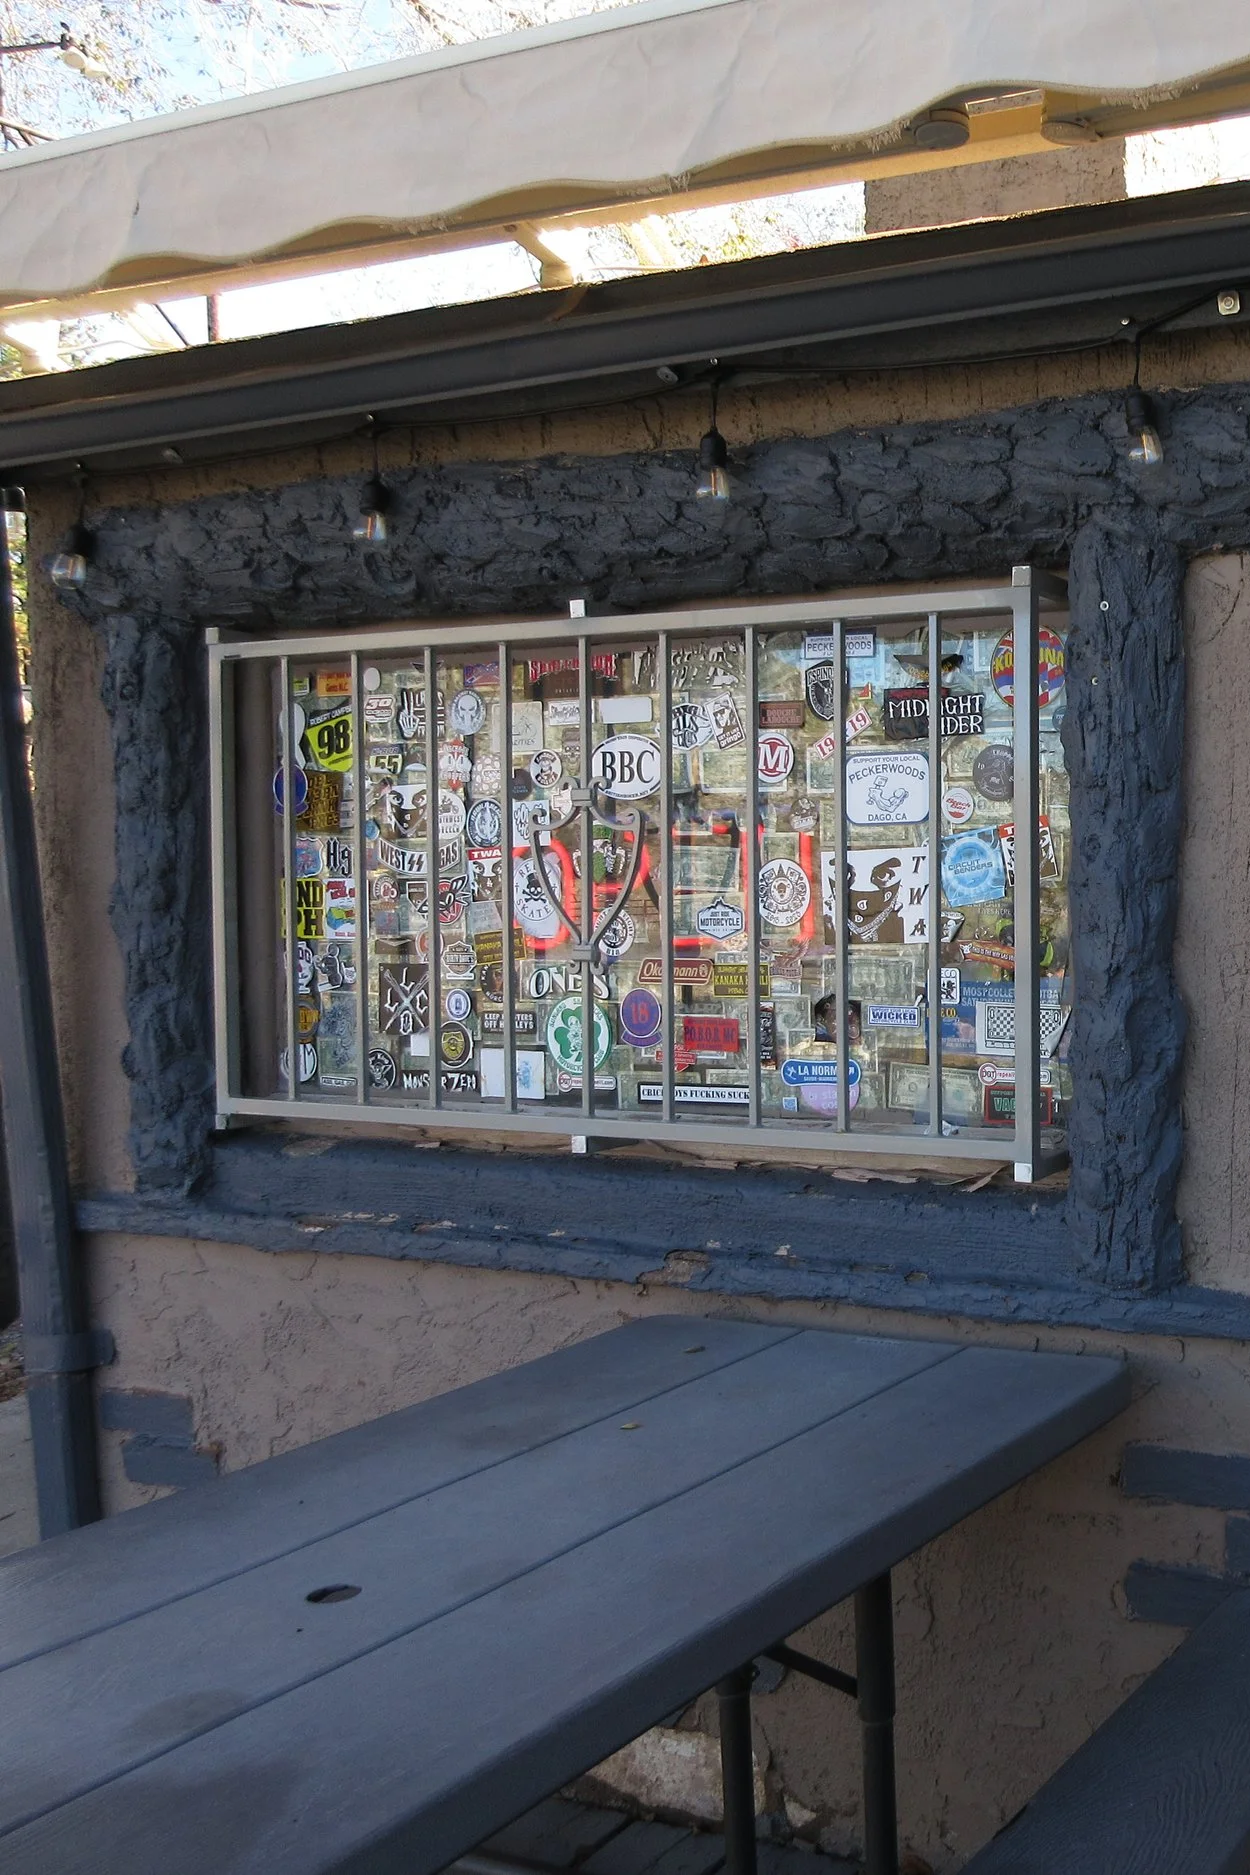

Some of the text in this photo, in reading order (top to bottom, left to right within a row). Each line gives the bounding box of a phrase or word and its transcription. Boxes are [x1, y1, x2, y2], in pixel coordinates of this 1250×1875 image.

[807, 641, 872, 652] PECKEOODS
[889, 694, 985, 718] MIDIGHT
[928, 714, 983, 735] IDER
[318, 719, 350, 760] 98
[600, 750, 655, 784] BBC
[848, 764, 926, 784] PECKERWOODS
[868, 813, 907, 822] DAGO, CA
[380, 841, 407, 870] WEST
[948, 858, 981, 871] CIRCUIT
[954, 861, 993, 876] BENDERS
[516, 898, 552, 918] SKATE
[700, 918, 740, 926] MOTORCYCLE
[872, 1012, 916, 1020] WICKED
[499, 1021, 534, 1029] HLEYS
[798, 1065, 809, 1075] LA
[690, 1090, 727, 1099] FUCKING
